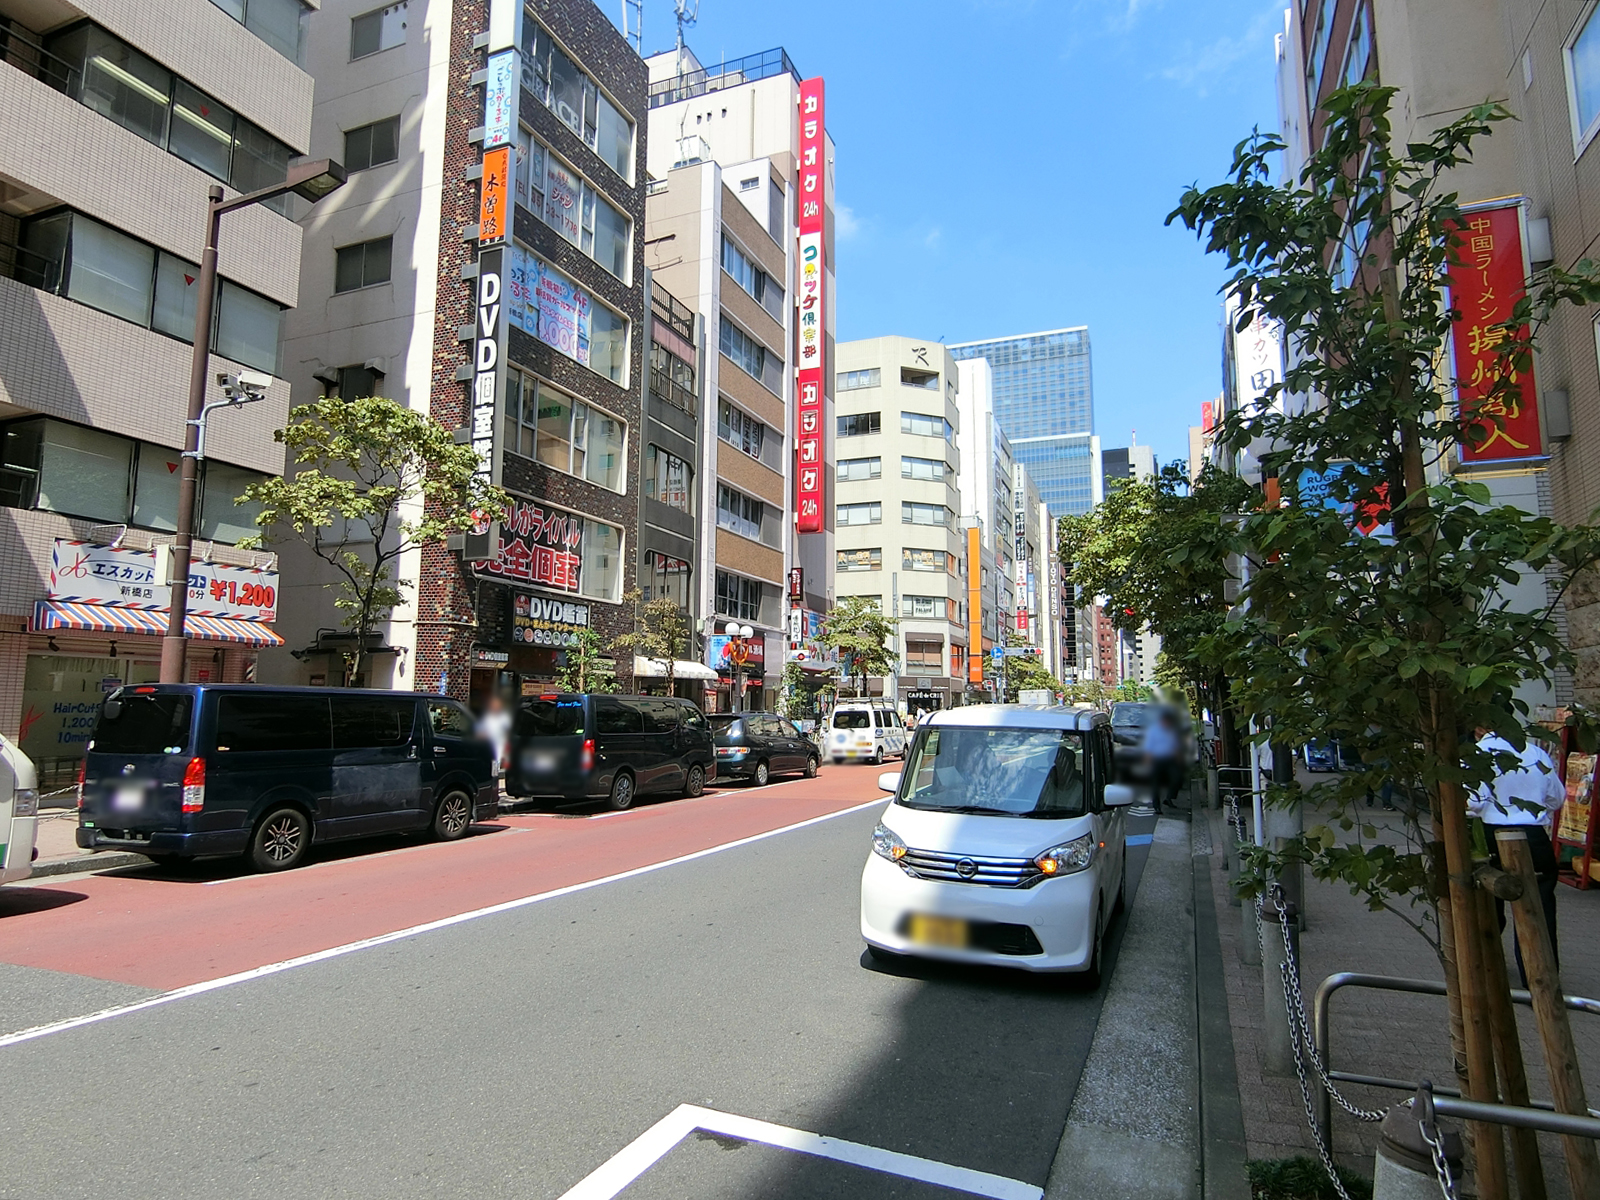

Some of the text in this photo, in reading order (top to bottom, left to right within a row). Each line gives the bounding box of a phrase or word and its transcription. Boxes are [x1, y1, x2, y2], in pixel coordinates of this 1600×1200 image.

[804, 96, 817, 192] カラオケ
[803, 201, 818, 218] 24h
[1470, 218, 1498, 320] 中国ラーメン
[1250, 316, 1275, 394] 串カツ田
[472, 272, 500, 492] DVD個室鑑
[803, 384, 817, 488] カラオケ
[1306, 474, 1341, 484] RUGB
[802, 499, 818, 516] 24h
[93, 563, 154, 582] エスカット
[188, 574, 206, 587] ット
[120, 585, 154, 599] 新橋店
[188, 588, 205, 600] 0分
[209, 579, 275, 608] ¥1,200
[530, 597, 588, 626] DVD鑑賞
